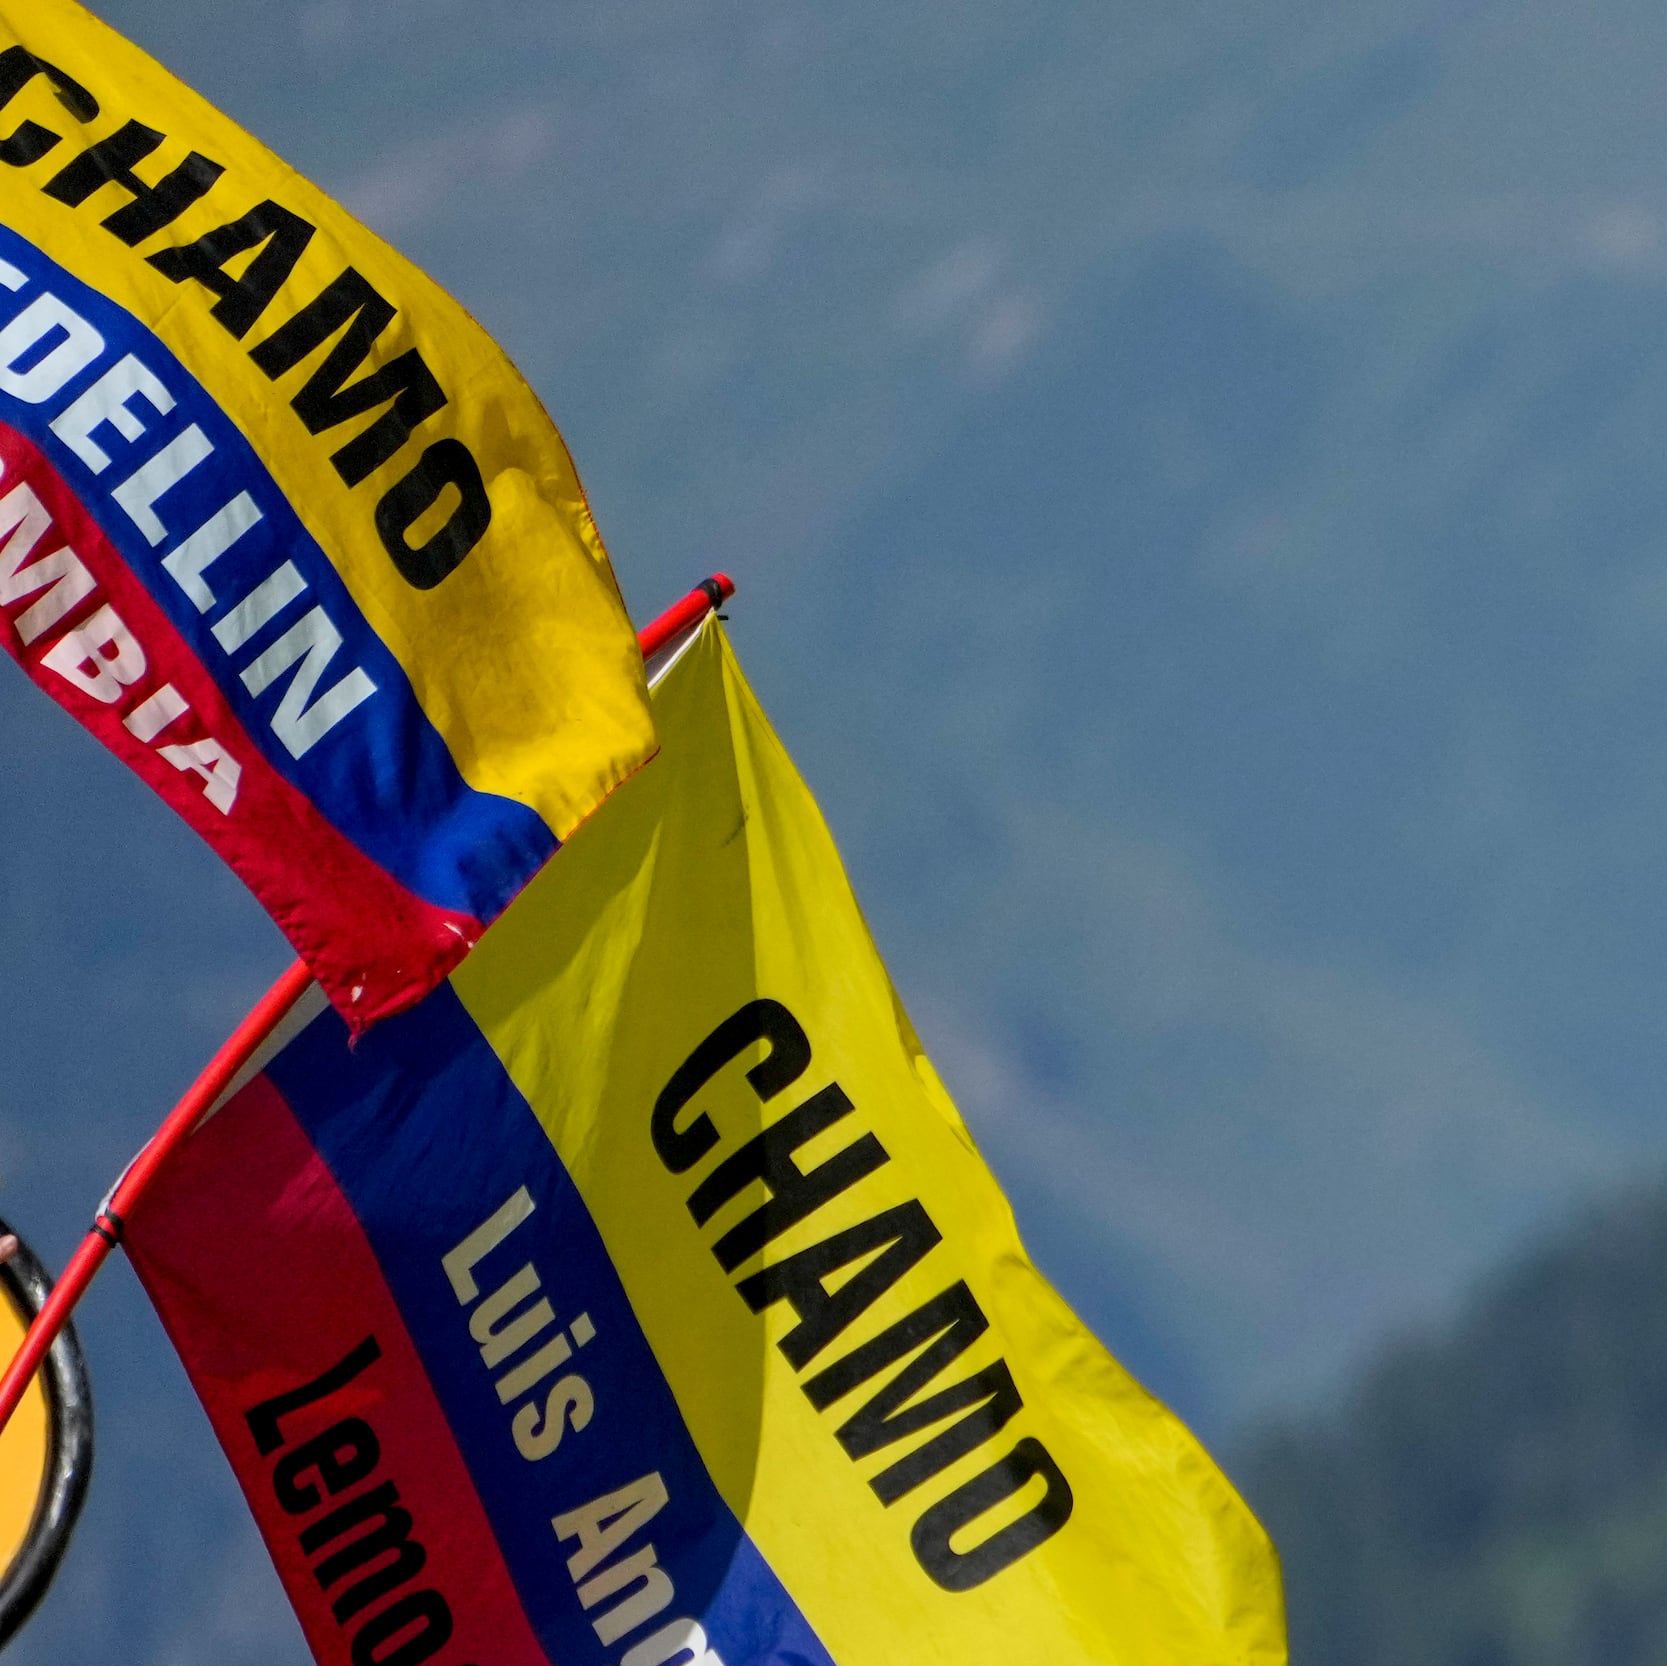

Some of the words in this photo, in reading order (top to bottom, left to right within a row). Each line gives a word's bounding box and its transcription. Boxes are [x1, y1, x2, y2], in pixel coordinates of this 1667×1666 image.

[0, 45, 491, 590] CHAMO
[0, 258, 378, 761] DELLIN
[0, 457, 242, 816] MBIA
[440, 1186, 594, 1462] Luis
[651, 998, 1073, 1594] CHAMO
